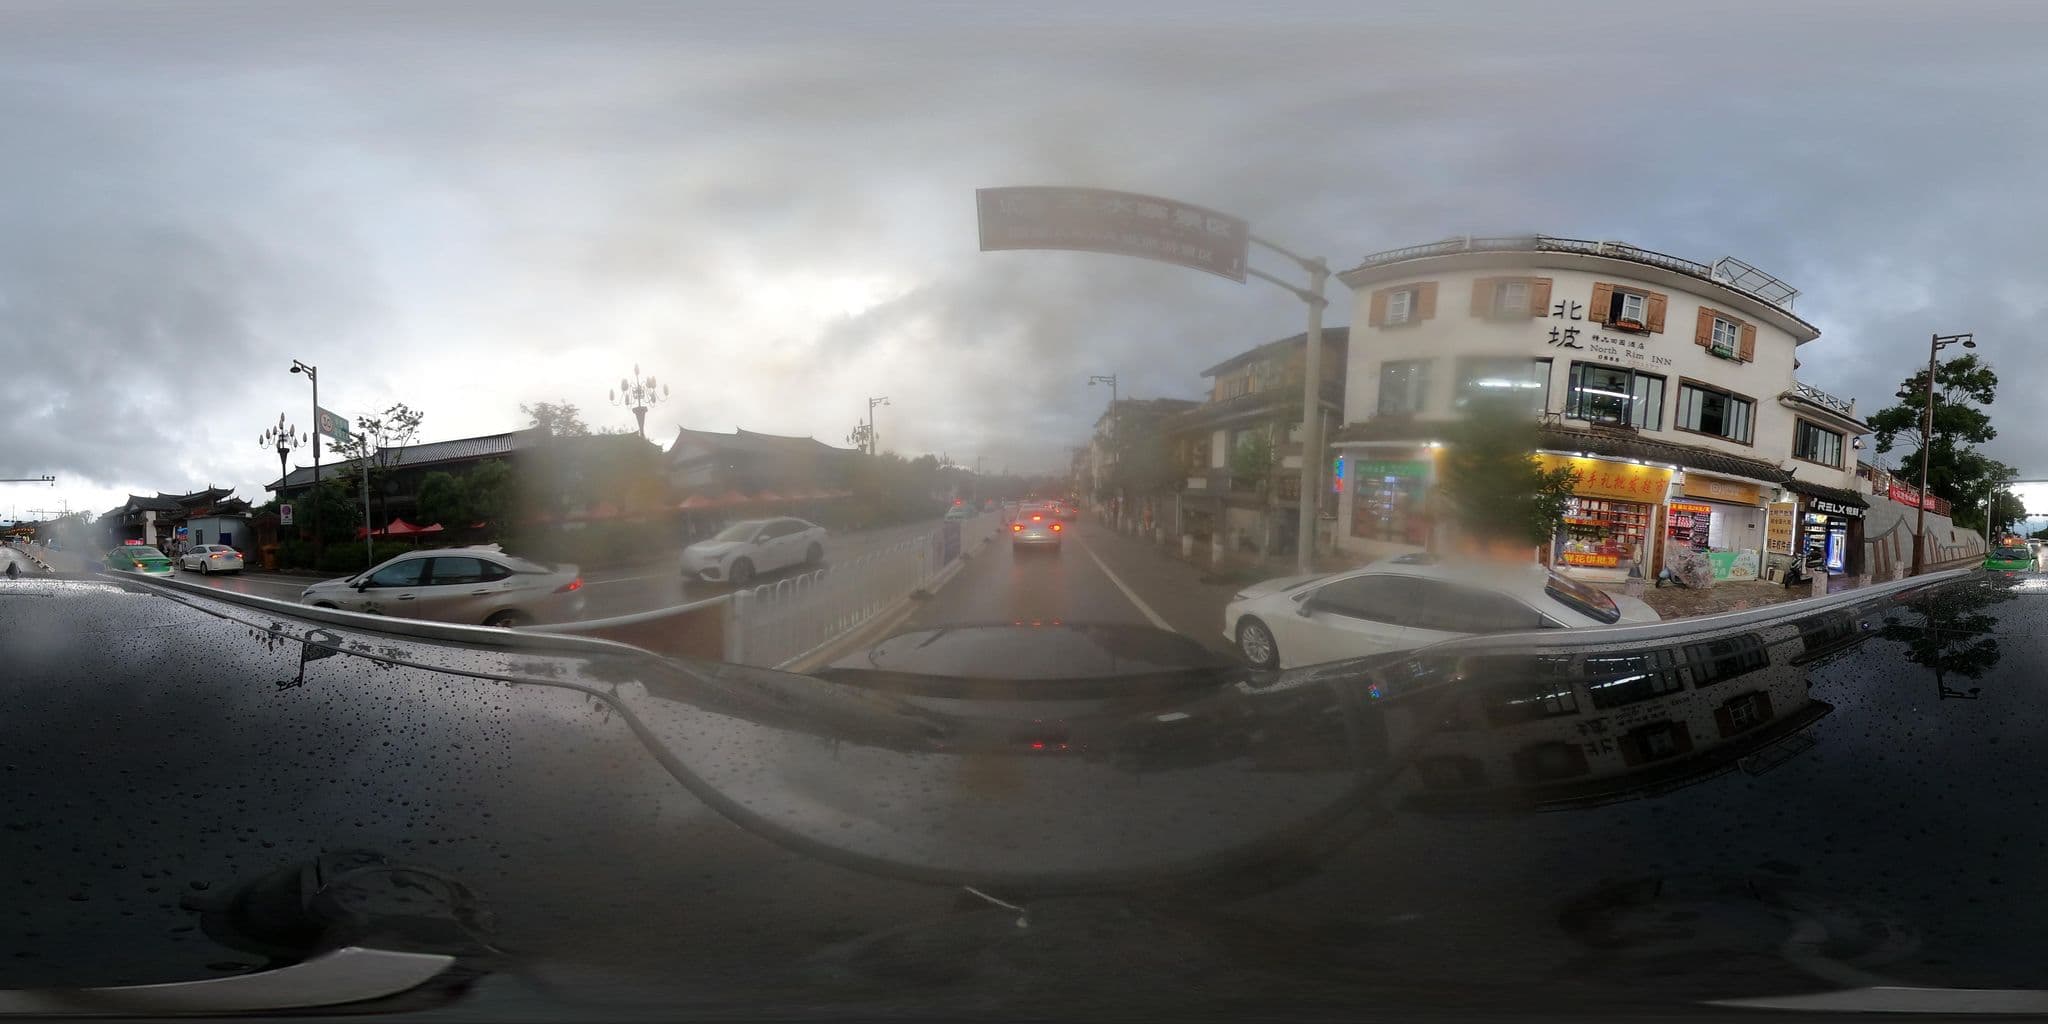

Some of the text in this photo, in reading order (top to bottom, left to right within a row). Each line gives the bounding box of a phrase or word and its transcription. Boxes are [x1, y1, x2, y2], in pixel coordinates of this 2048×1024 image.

[1548, 299, 1583, 349] 北坡
[1590, 344, 1618, 355] North
[1625, 349, 1645, 361] Rim
[1651, 355, 1672, 366] INN
[1817, 500, 1846, 515] RELX
